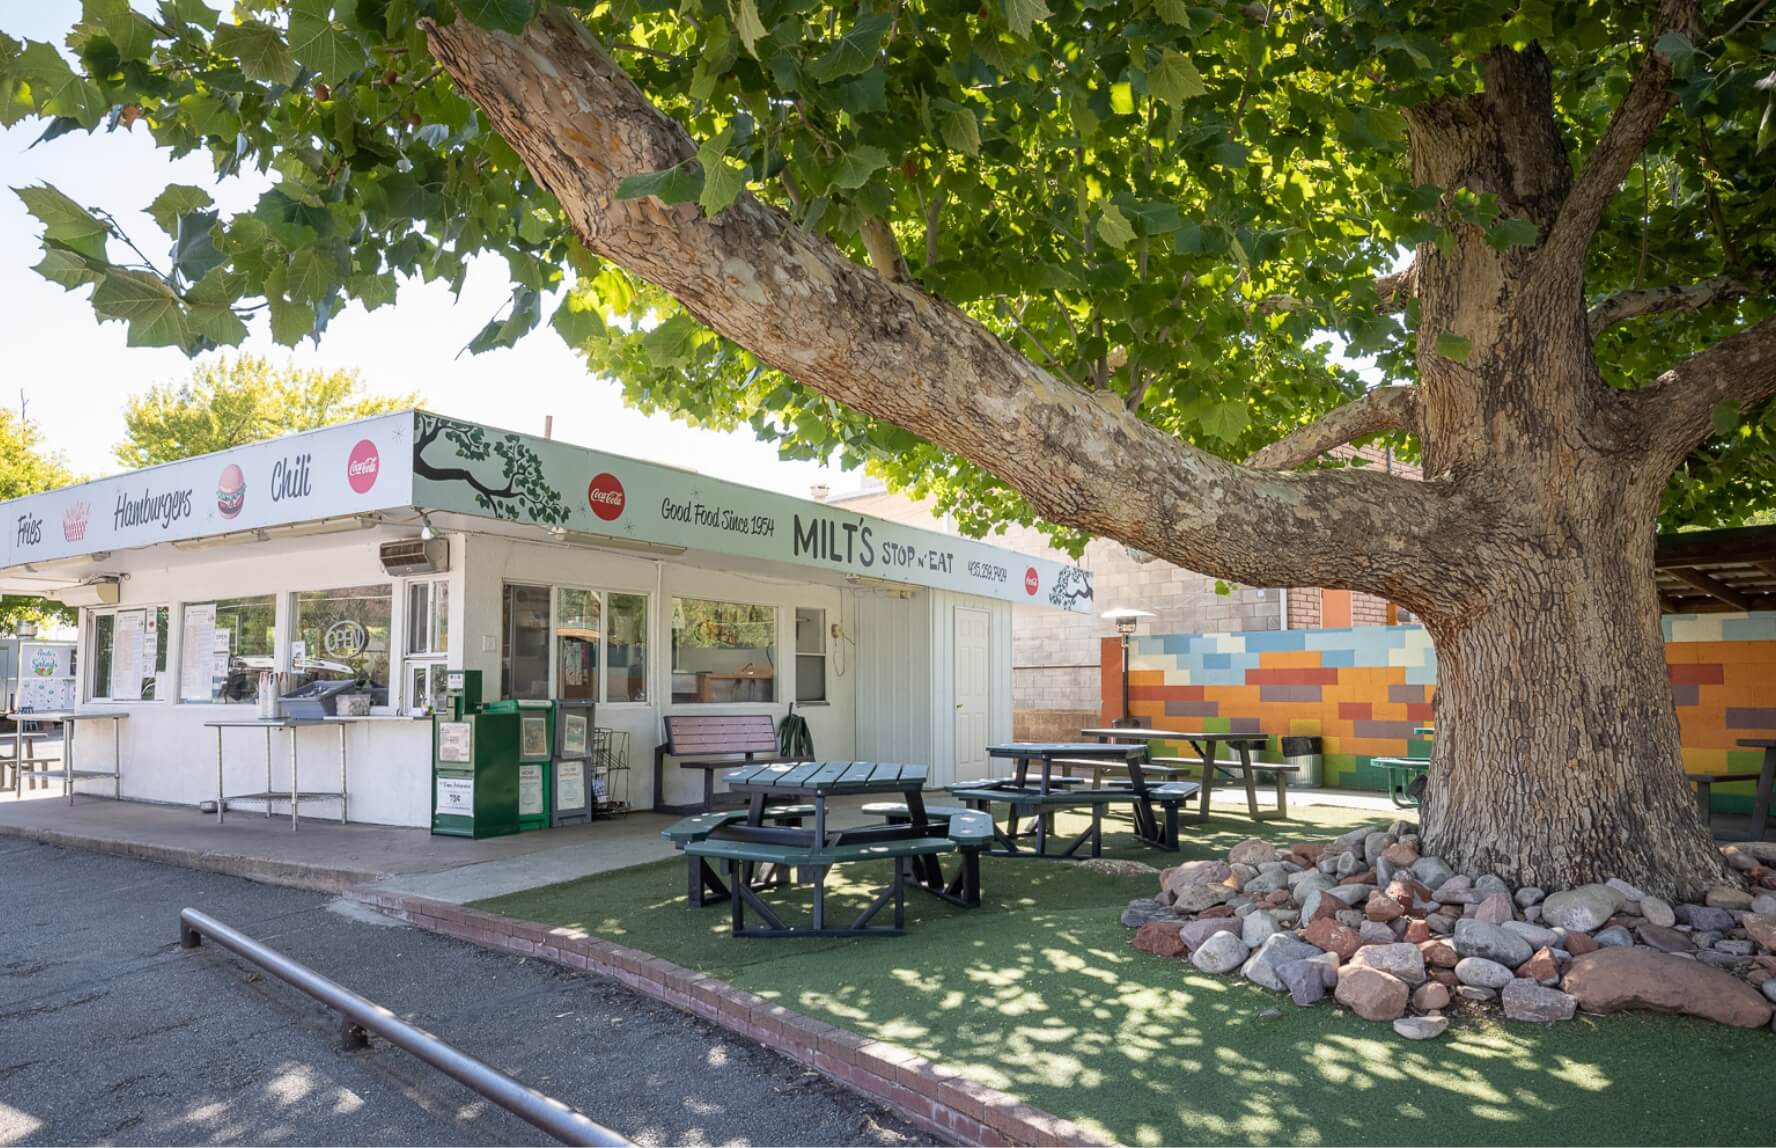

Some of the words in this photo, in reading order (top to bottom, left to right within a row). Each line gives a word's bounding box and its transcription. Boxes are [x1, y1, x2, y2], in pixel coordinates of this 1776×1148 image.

[271, 453, 312, 502] Chili
[349, 456, 377, 476] Coca-Cola
[114, 488, 193, 531] Hamburgers
[590, 488, 623, 506] Coca-Cola
[16, 512, 43, 547] Fries
[661, 497, 692, 523] Good
[694, 503, 720, 528] Food
[721, 510, 749, 535] Since
[750, 515, 775, 537] 1954
[793, 513, 875, 568] MILT'S
[881, 541, 915, 568] STOP
[929, 550, 954, 574] EAT
[327, 624, 362, 652] OPEN
